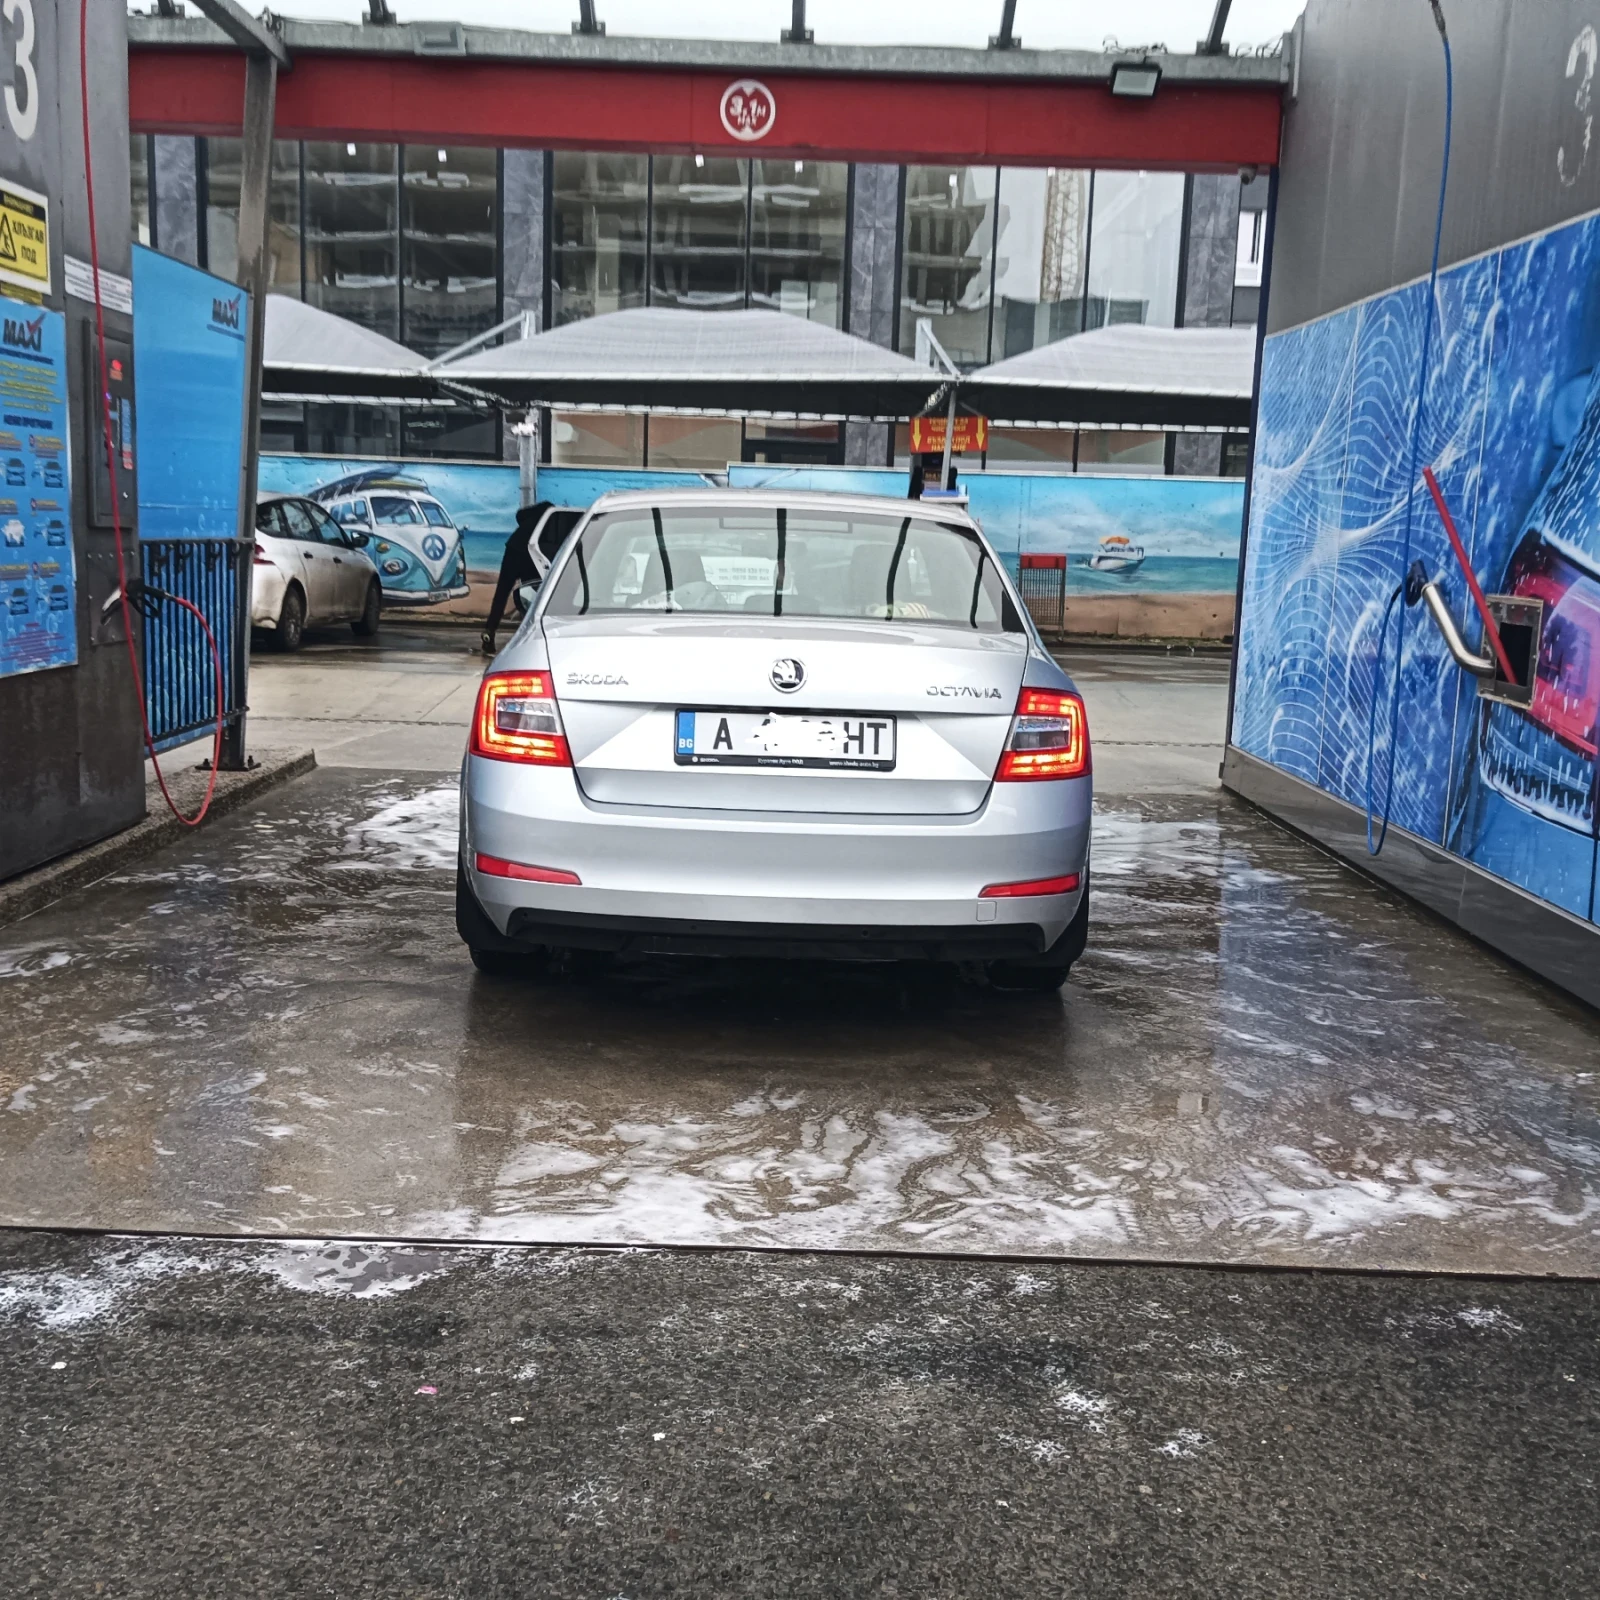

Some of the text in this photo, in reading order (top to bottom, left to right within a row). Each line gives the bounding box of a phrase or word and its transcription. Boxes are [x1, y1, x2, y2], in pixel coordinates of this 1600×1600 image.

[3, 0, 38, 140] 3
[12, 220, 44, 244] ХЛЪЗГАВ
[21, 245, 37, 264] ПОД
[926, 685, 1002, 699] OCTAVIA
[678, 738, 694, 749] BG
[713, 717, 733, 750] A
